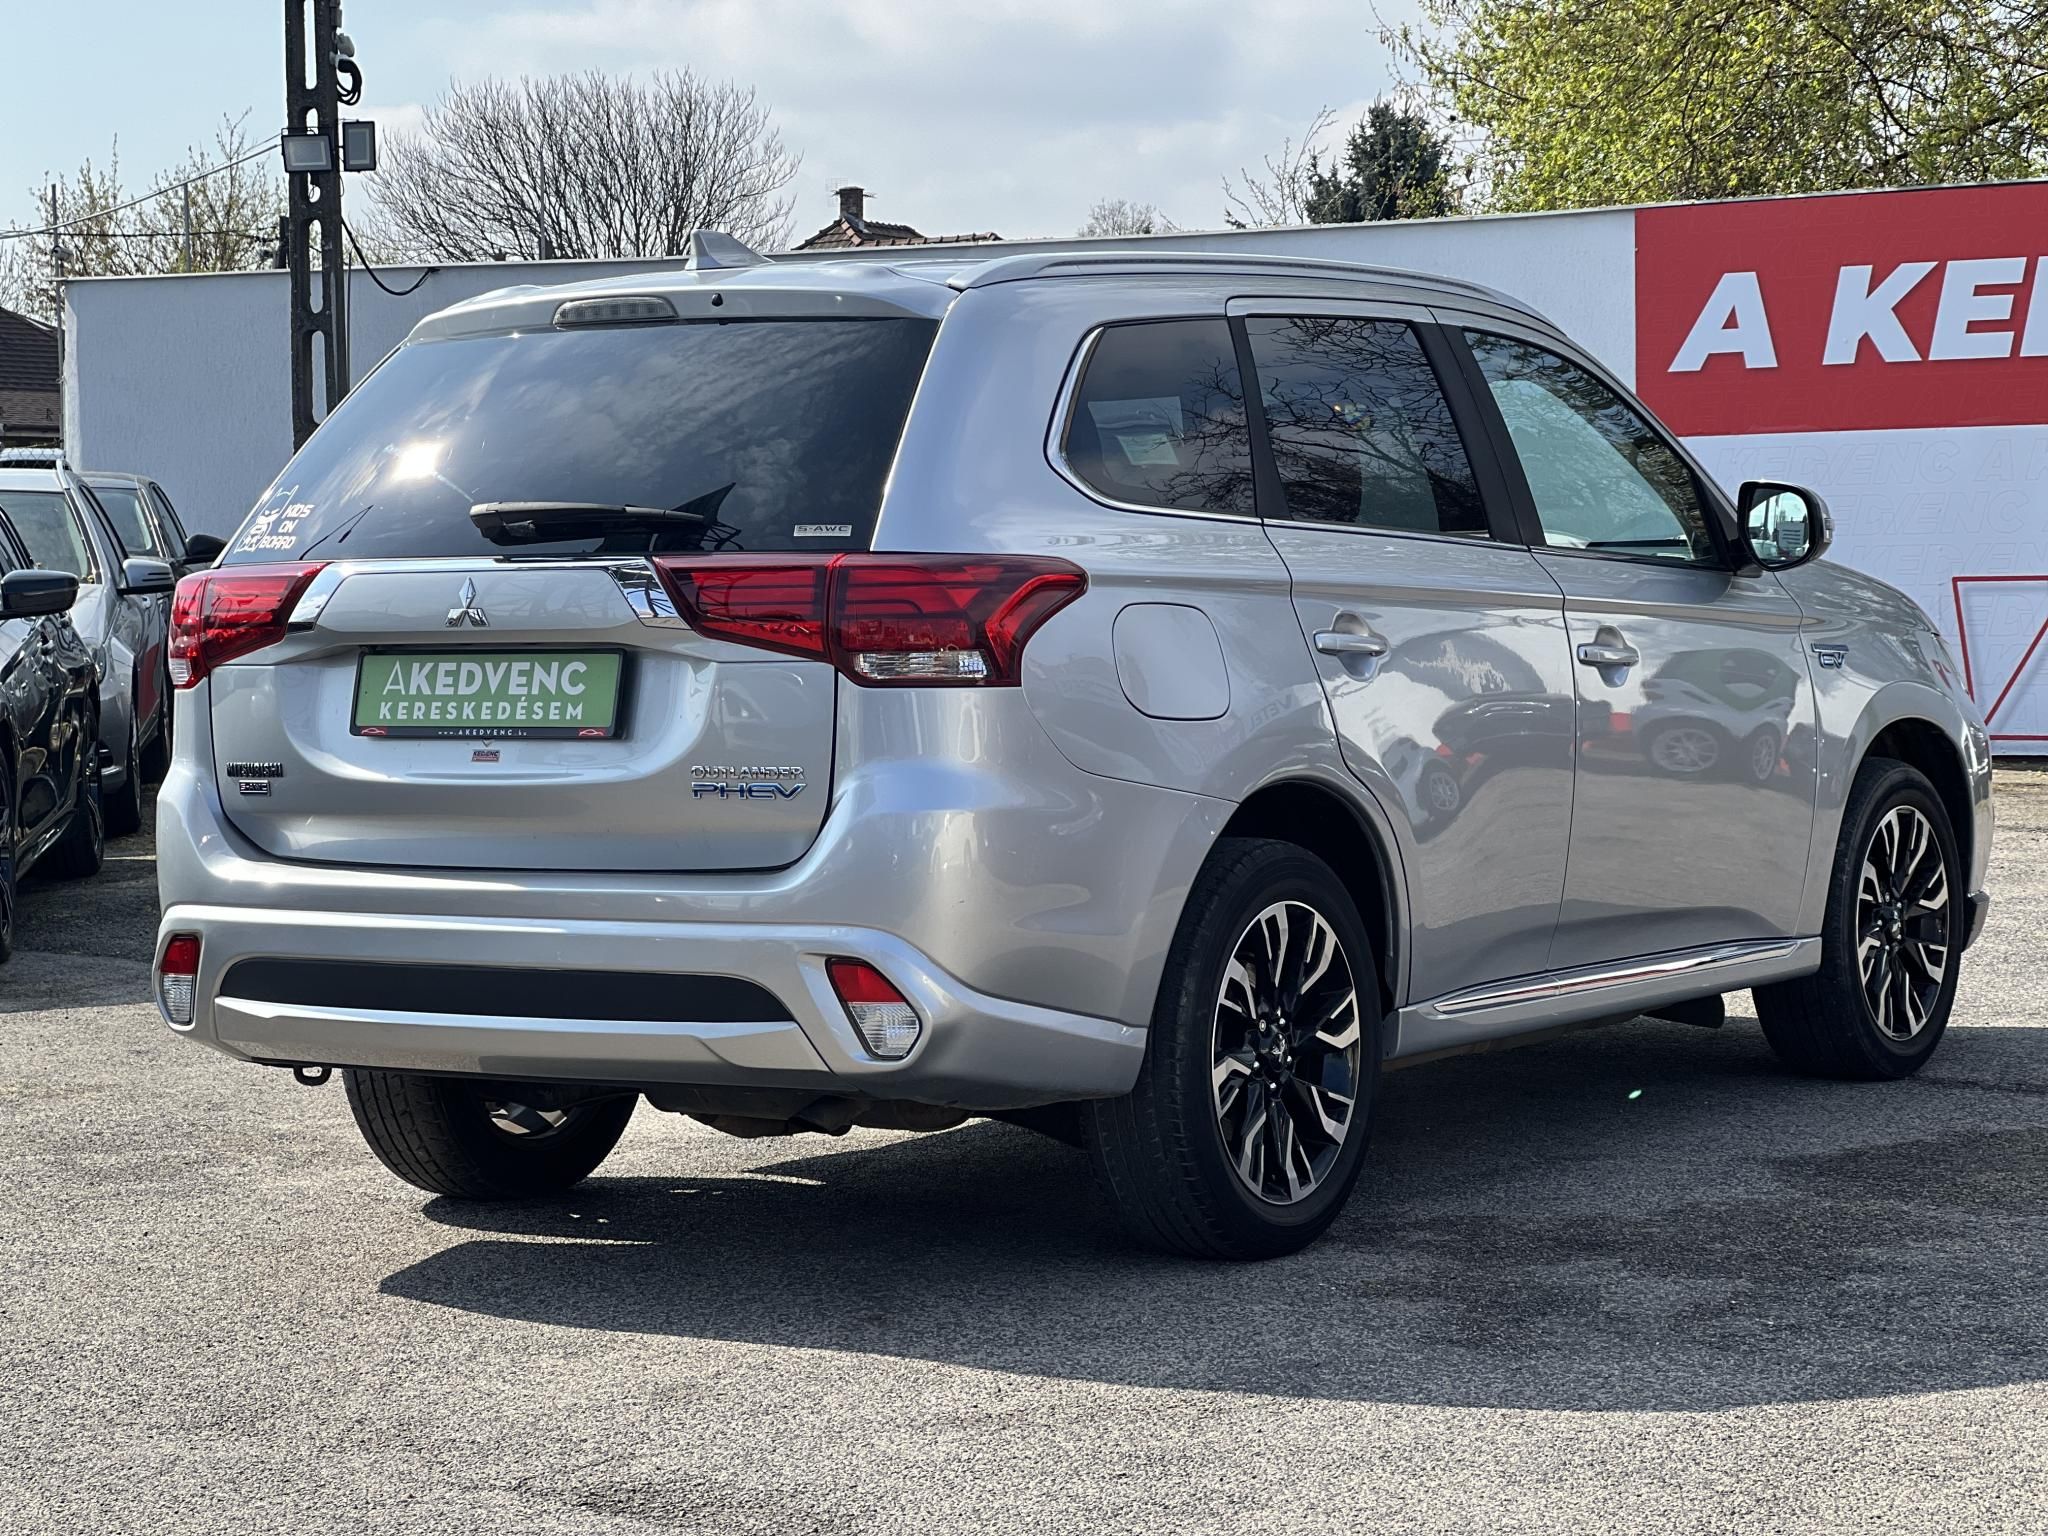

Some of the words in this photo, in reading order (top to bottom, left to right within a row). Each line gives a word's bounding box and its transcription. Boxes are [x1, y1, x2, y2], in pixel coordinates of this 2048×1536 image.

[1667, 271, 1778, 373] A
[1822, 255, 2048, 366] KE
[281, 503, 315, 519] KIDS
[278, 519, 299, 533] ON
[258, 535, 297, 550] BOARD
[379, 696, 583, 720] KERESKEDÉSEM
[226, 762, 284, 777] MITSUBISHI
[691, 765, 805, 780] OUTLANDER
[691, 782, 807, 800] PHEV
